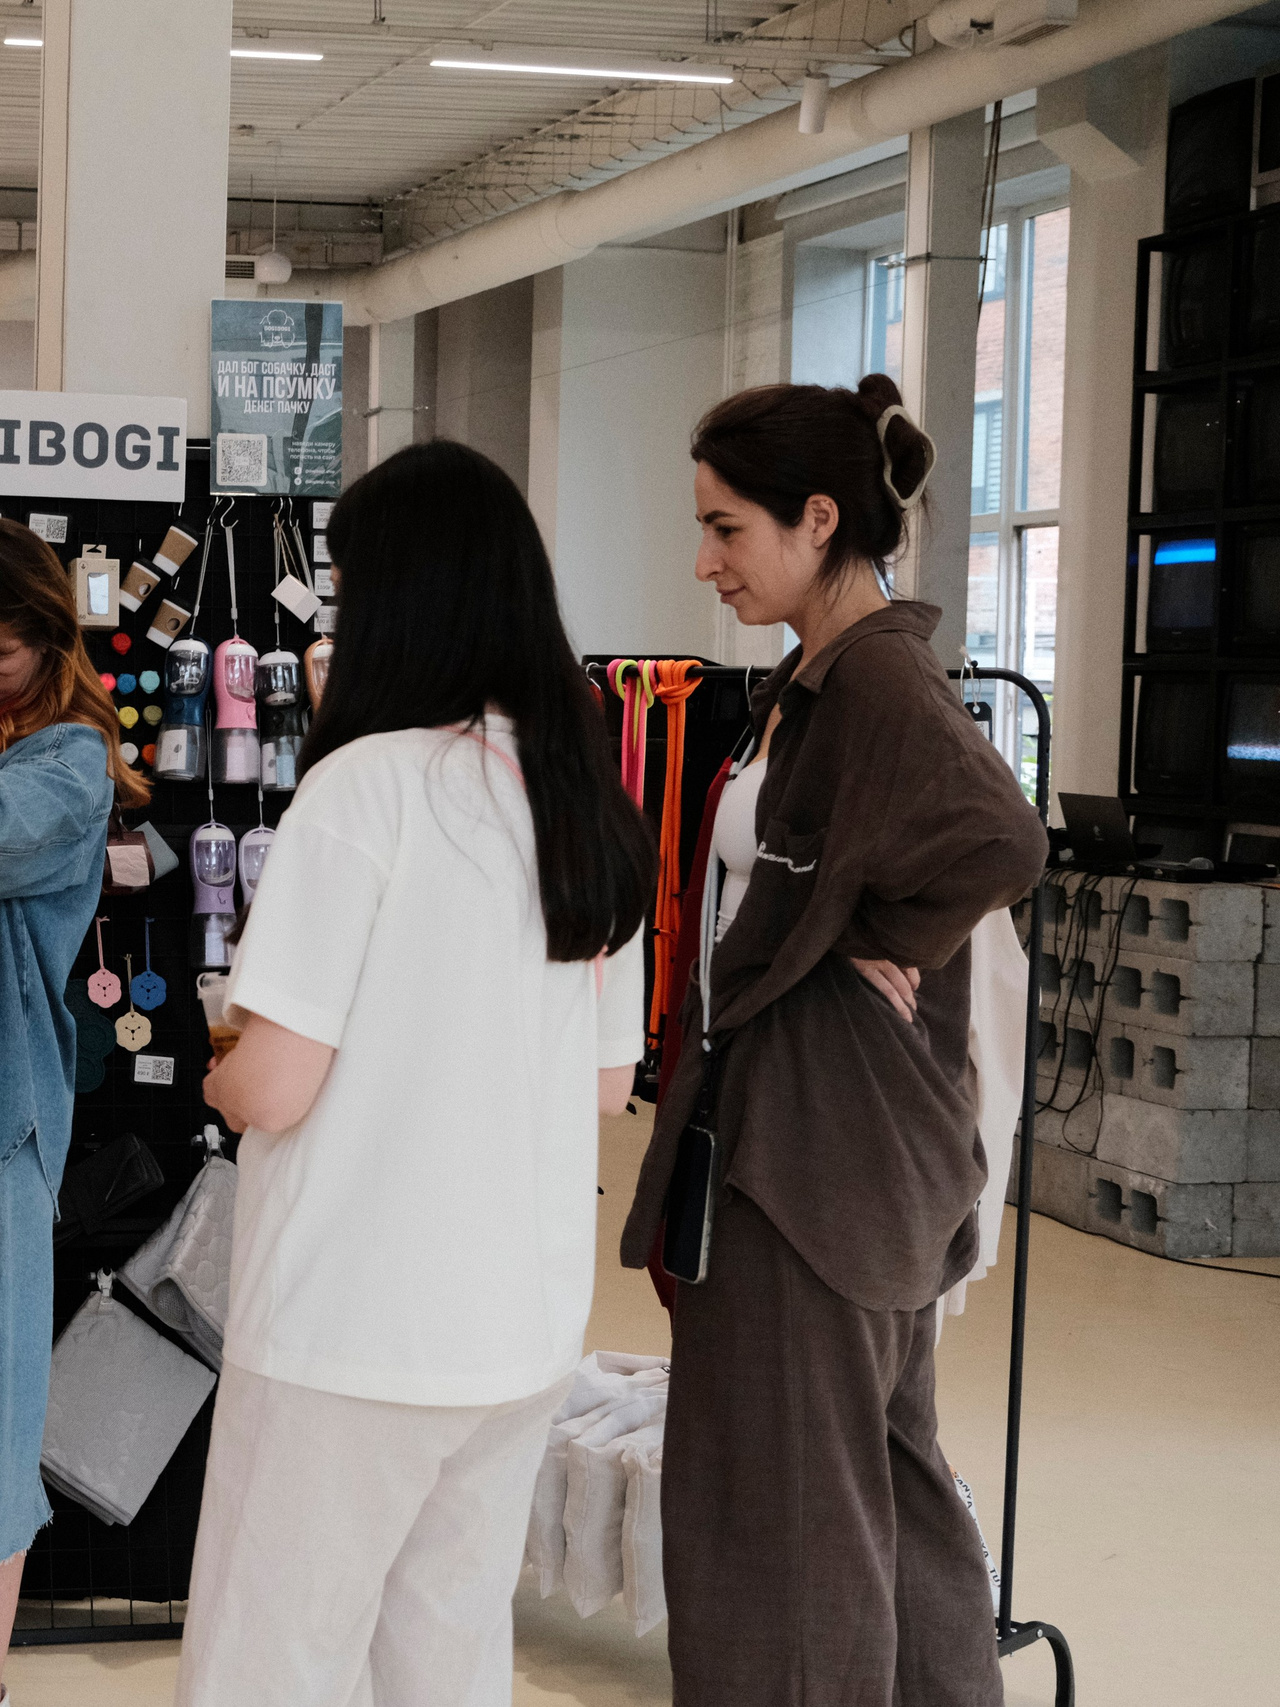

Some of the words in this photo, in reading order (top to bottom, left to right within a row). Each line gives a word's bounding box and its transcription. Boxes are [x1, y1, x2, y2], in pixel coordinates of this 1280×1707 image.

[217, 360, 238, 374] ДАЛ
[241, 361, 259, 374] БОГ
[261, 361, 308, 376] СОБАЧКУ,
[310, 363, 336, 377] ДАСТ
[217, 375, 229, 397] И
[235, 375, 258, 398] НА
[262, 376, 336, 400] ПСУМКУ
[243, 400, 275, 414] ДЕНЕГ
[277, 401, 310, 414] ПАЧКУ
